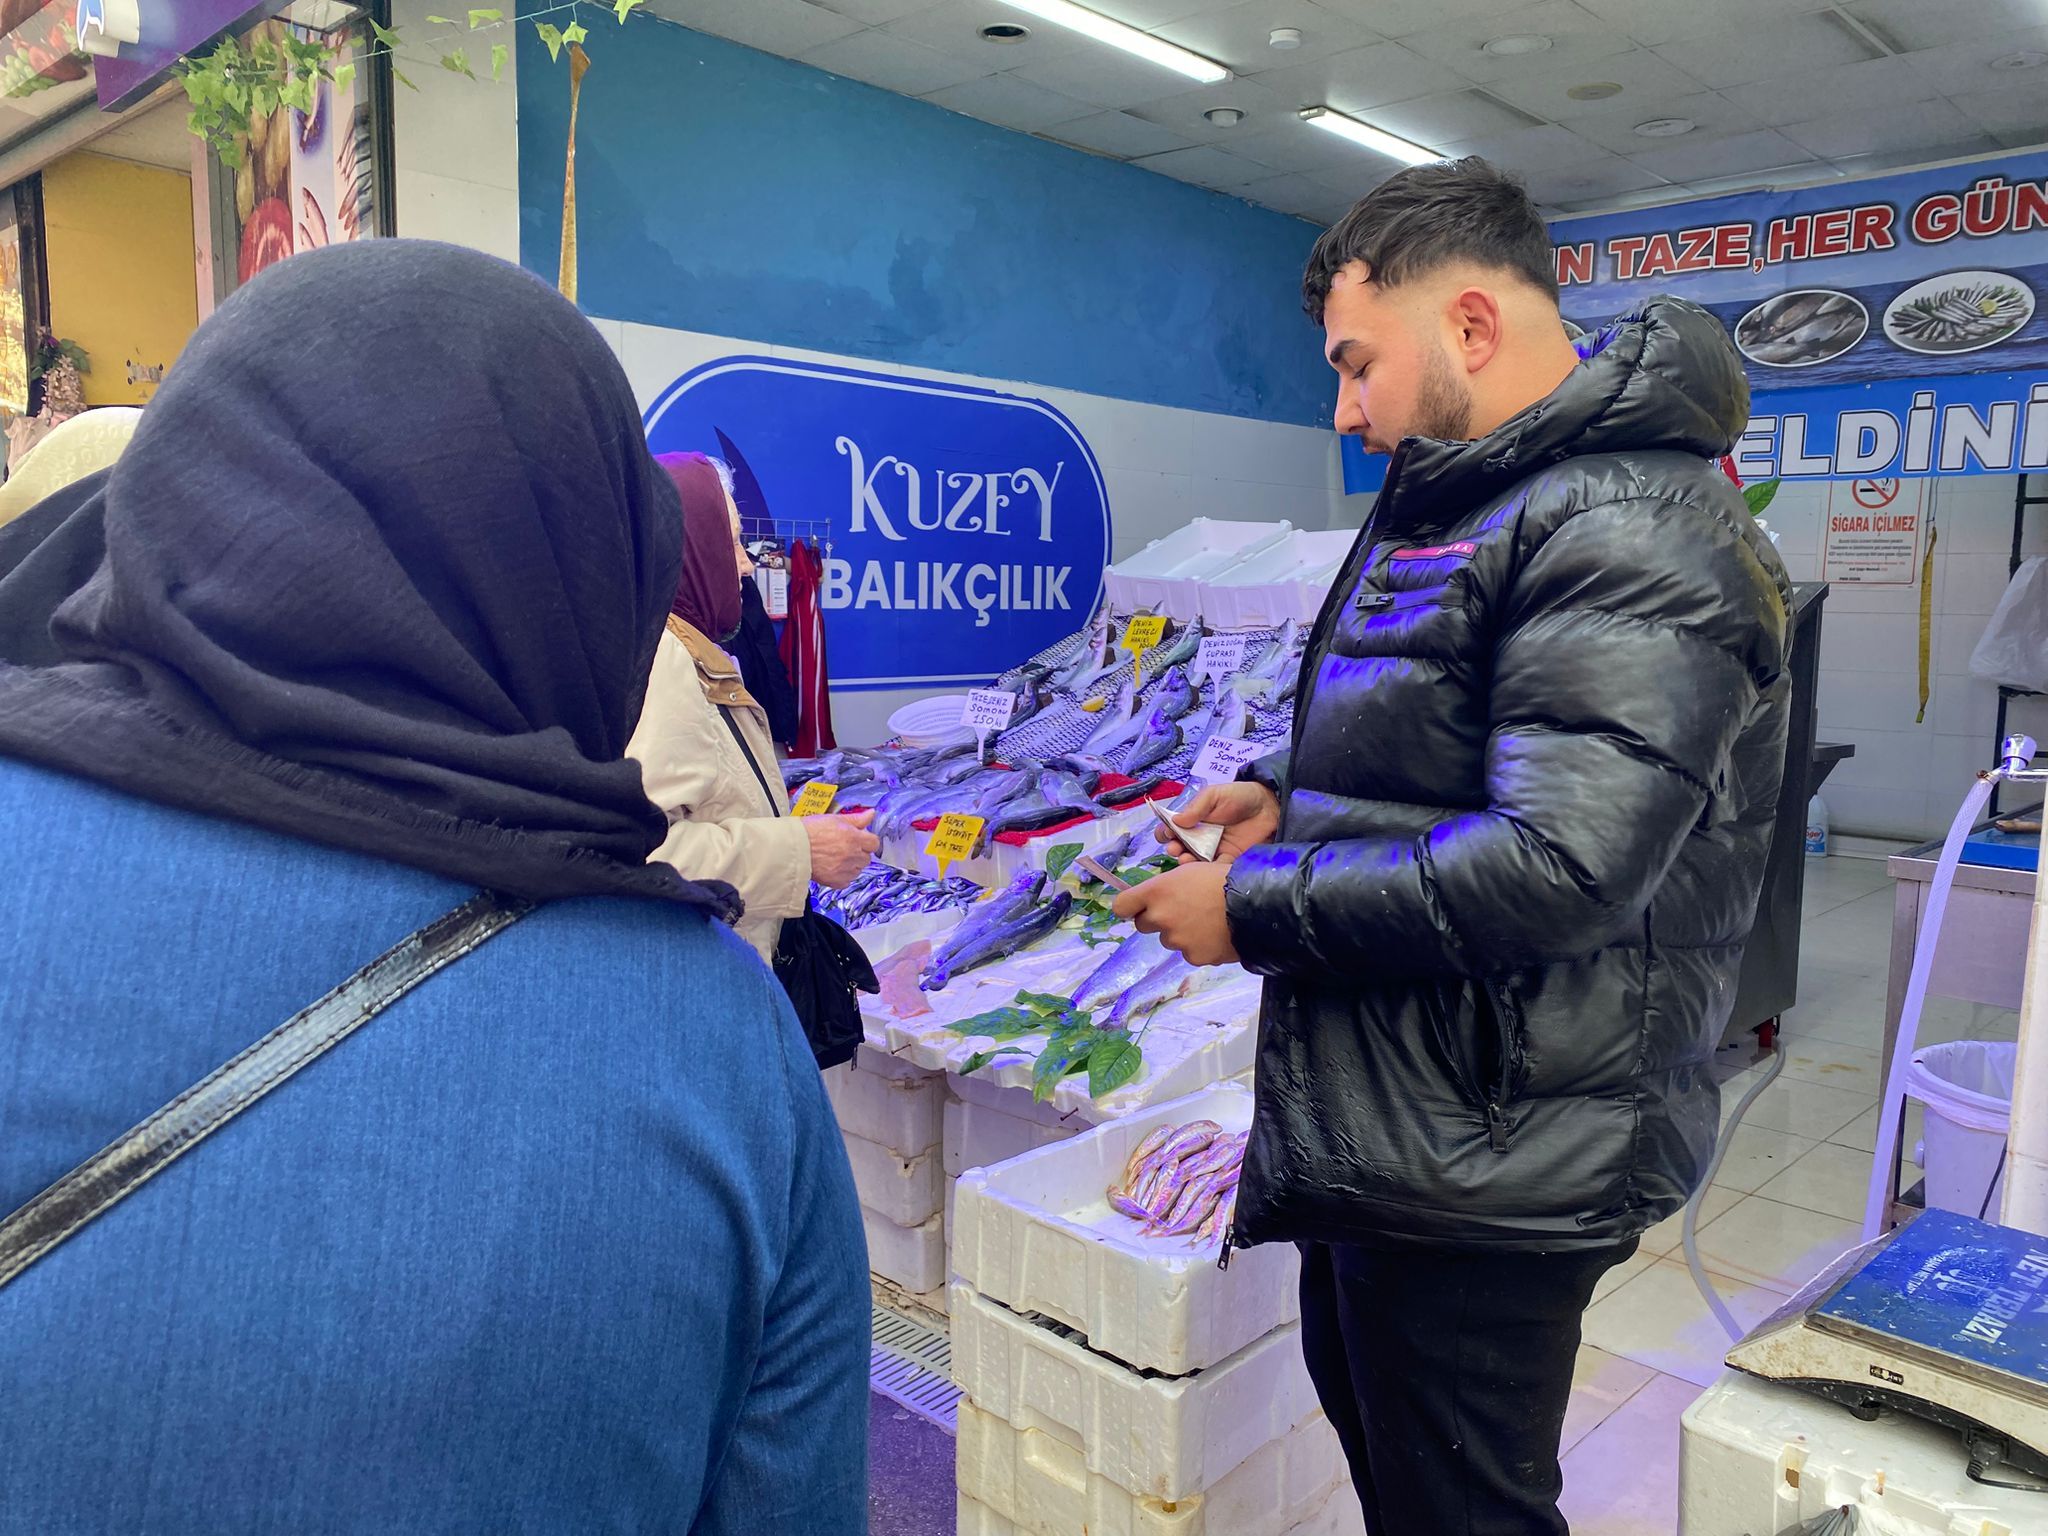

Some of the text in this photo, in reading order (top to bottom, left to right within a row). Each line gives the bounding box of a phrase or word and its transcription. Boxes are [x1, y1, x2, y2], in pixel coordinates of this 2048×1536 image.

[1550, 243, 1595, 286] N
[1737, 384, 2048, 477] ELDİNİ
[835, 435, 1065, 542] KUZEY
[1831, 512, 1915, 537] SİGARA İÇİLMEZ
[821, 558, 1072, 627] BALIKÇILIK
[1208, 761, 1230, 775] TAZE
